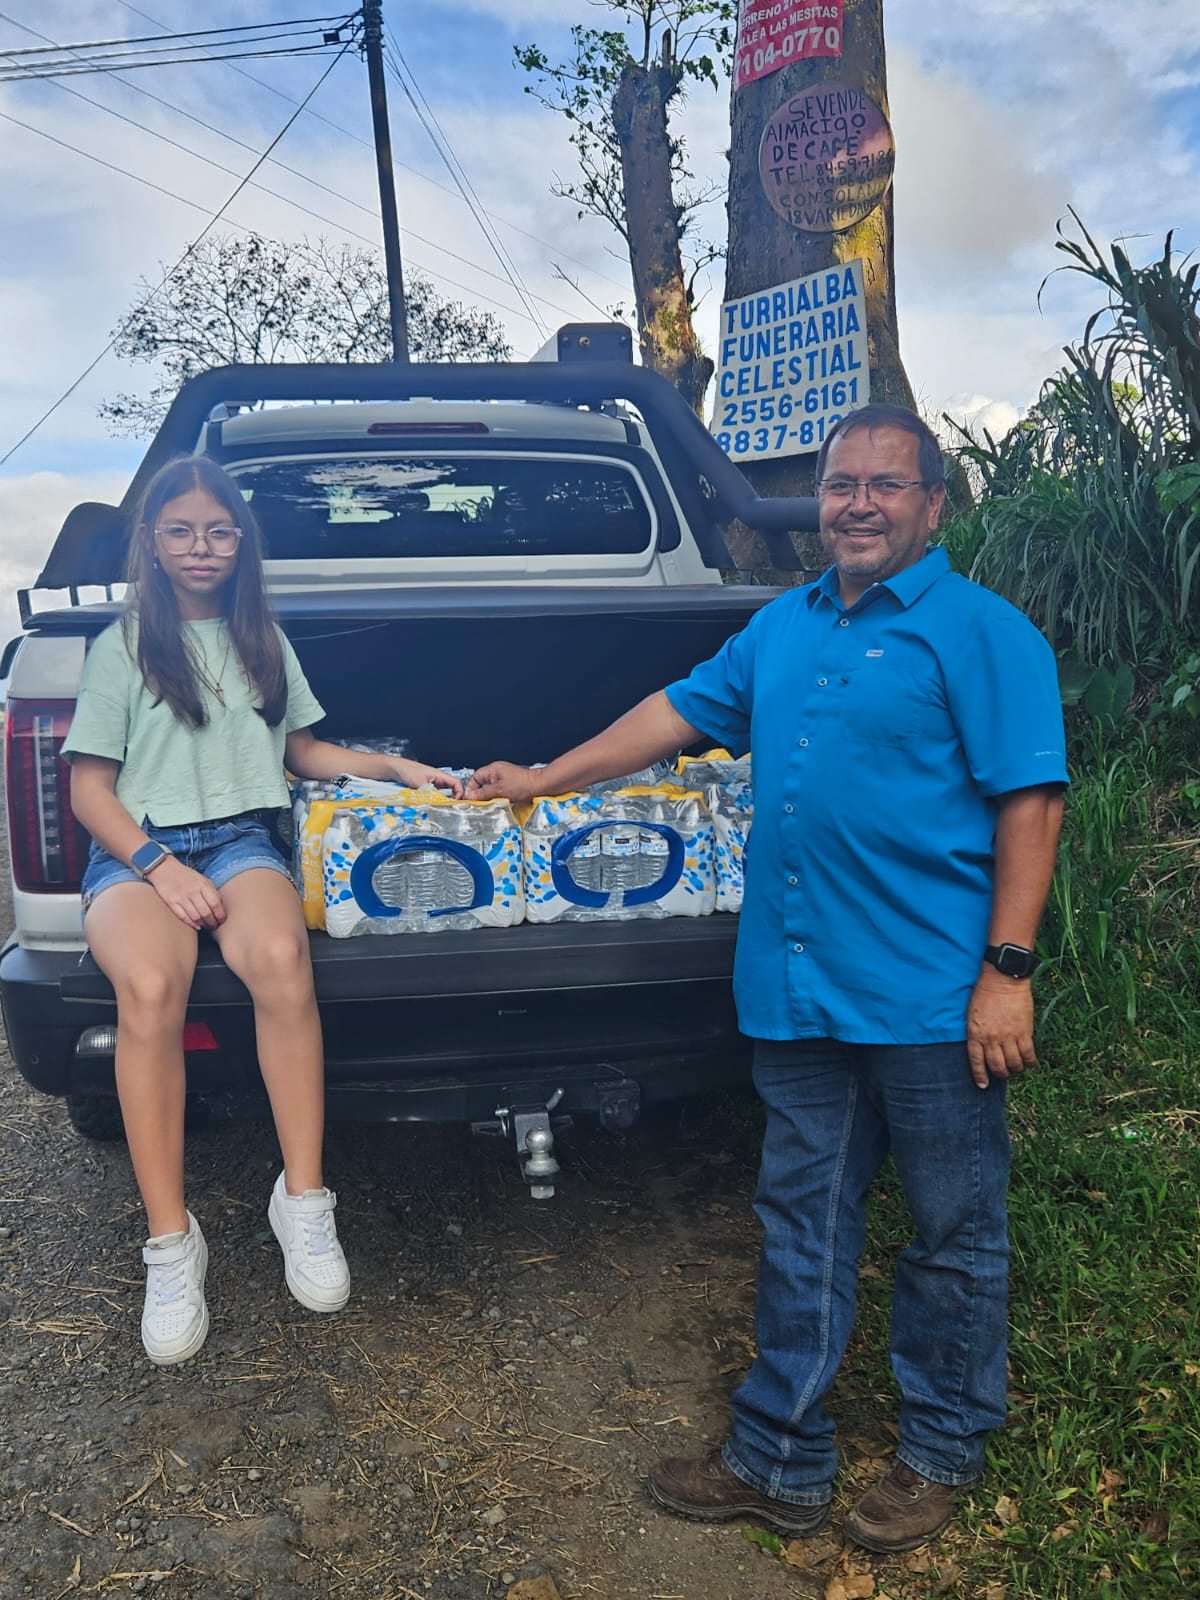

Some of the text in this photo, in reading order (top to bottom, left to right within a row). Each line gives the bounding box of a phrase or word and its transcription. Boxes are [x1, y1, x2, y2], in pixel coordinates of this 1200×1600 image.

[741, 3, 781, 29] ERRENO
[760, 27, 766, 39] A
[769, 18, 787, 36] LAS
[790, 6, 838, 26] MESITAS
[725, 267, 857, 334] TURRIALBA
[722, 303, 860, 367] FUNERARIA
[720, 340, 861, 398] CELESTIAL
[722, 377, 857, 427] 2556-6161
[716, 410, 853, 454] 8837-81
